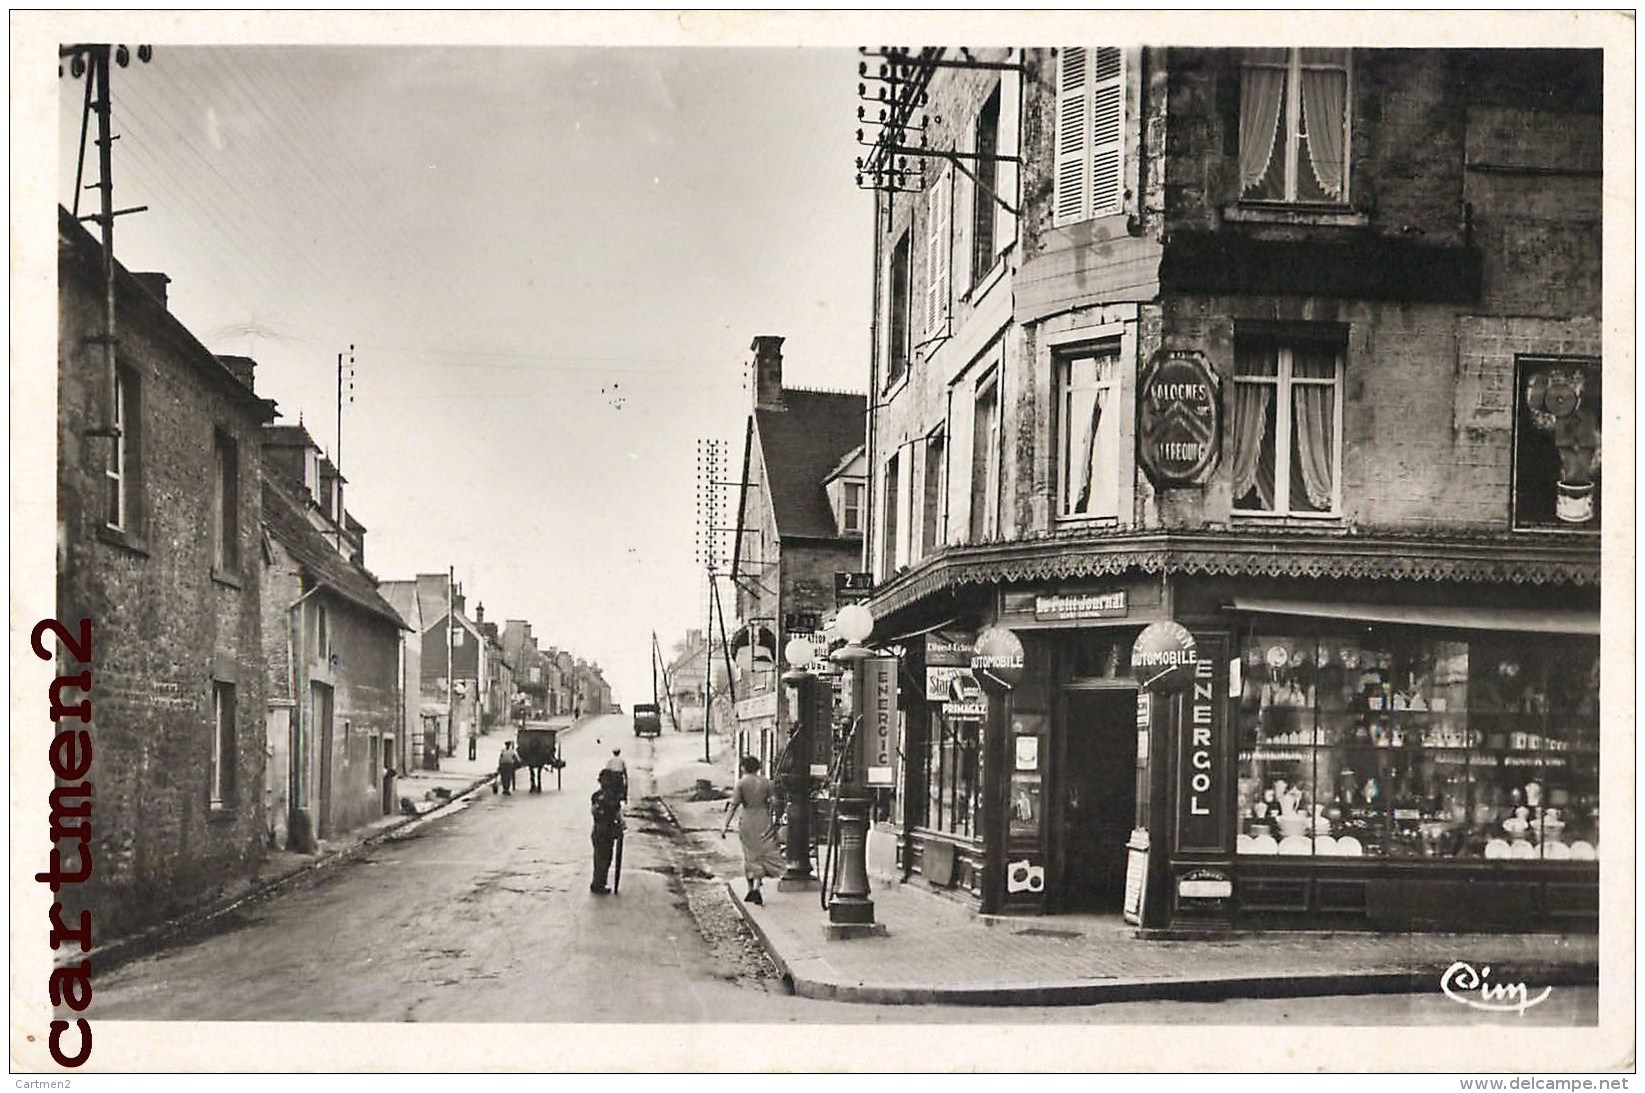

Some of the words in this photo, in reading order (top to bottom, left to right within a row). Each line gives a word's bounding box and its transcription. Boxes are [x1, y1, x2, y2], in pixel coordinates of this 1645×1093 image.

[1051, 594, 1078, 613] Petit
[1078, 591, 1125, 611] Journal
[970, 654, 1024, 669] AUTOMOBILE
[1131, 650, 1197, 667] AUTOMOBILE
[877, 670, 889, 765] ENERGIC
[942, 702, 988, 715] PRIMAGAZ
[1190, 657, 1213, 816] ENERGOL
